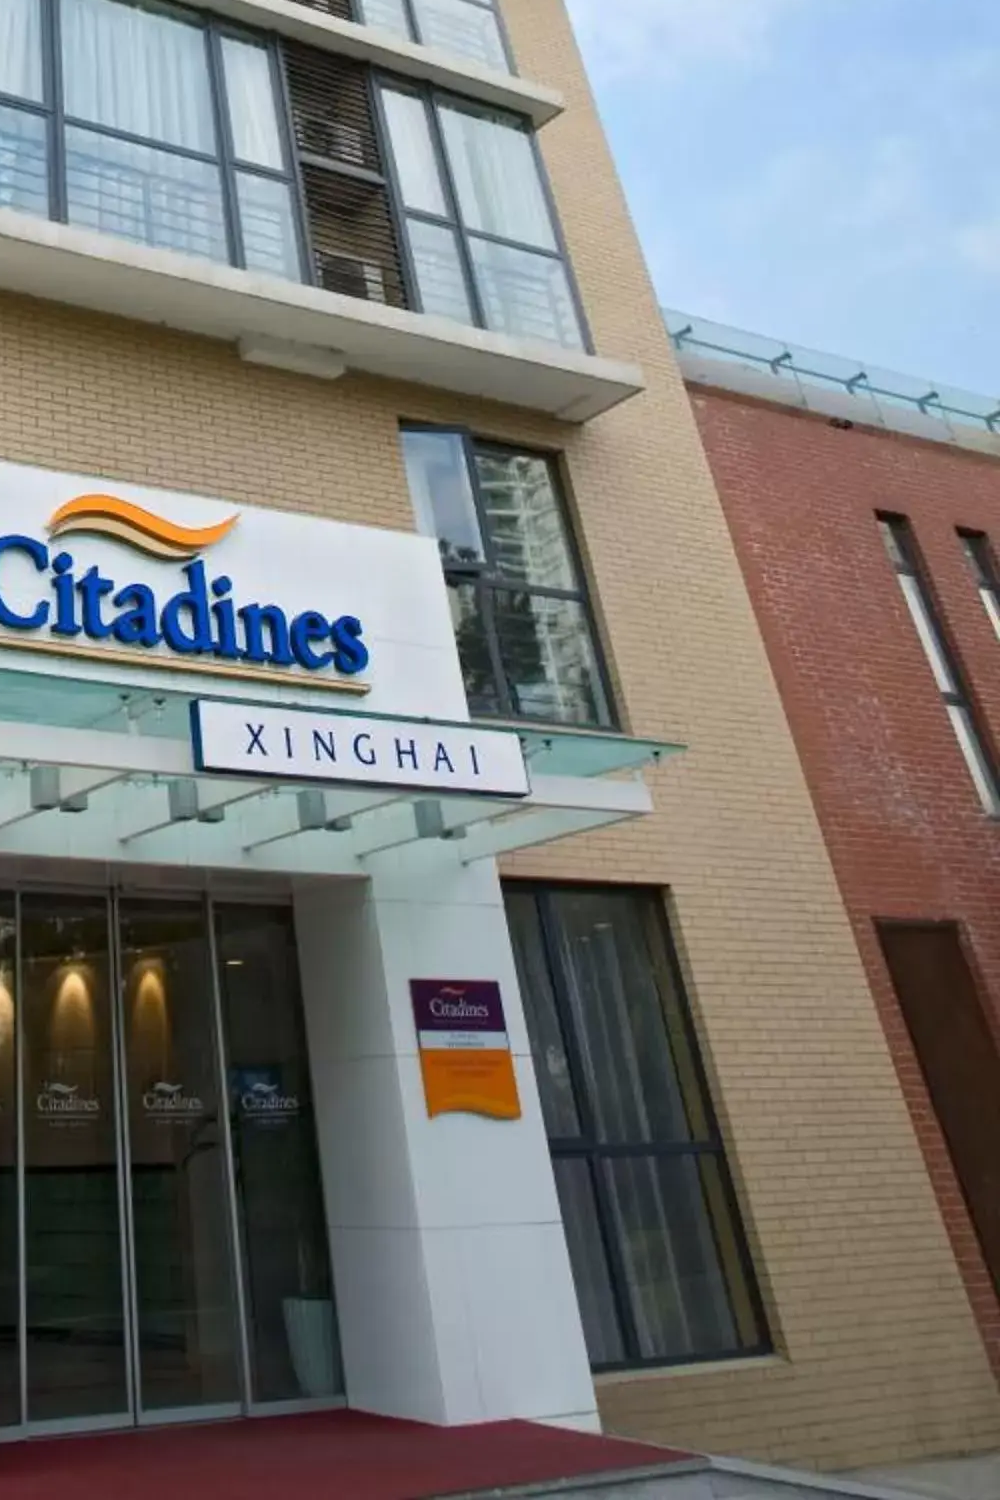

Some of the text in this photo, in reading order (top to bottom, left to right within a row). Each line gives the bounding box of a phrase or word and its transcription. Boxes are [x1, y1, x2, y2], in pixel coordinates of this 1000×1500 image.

[246, 723, 480, 775] XINGHAI
[429, 997, 489, 1018] Citadines
[37, 1094, 100, 1112] Citadines
